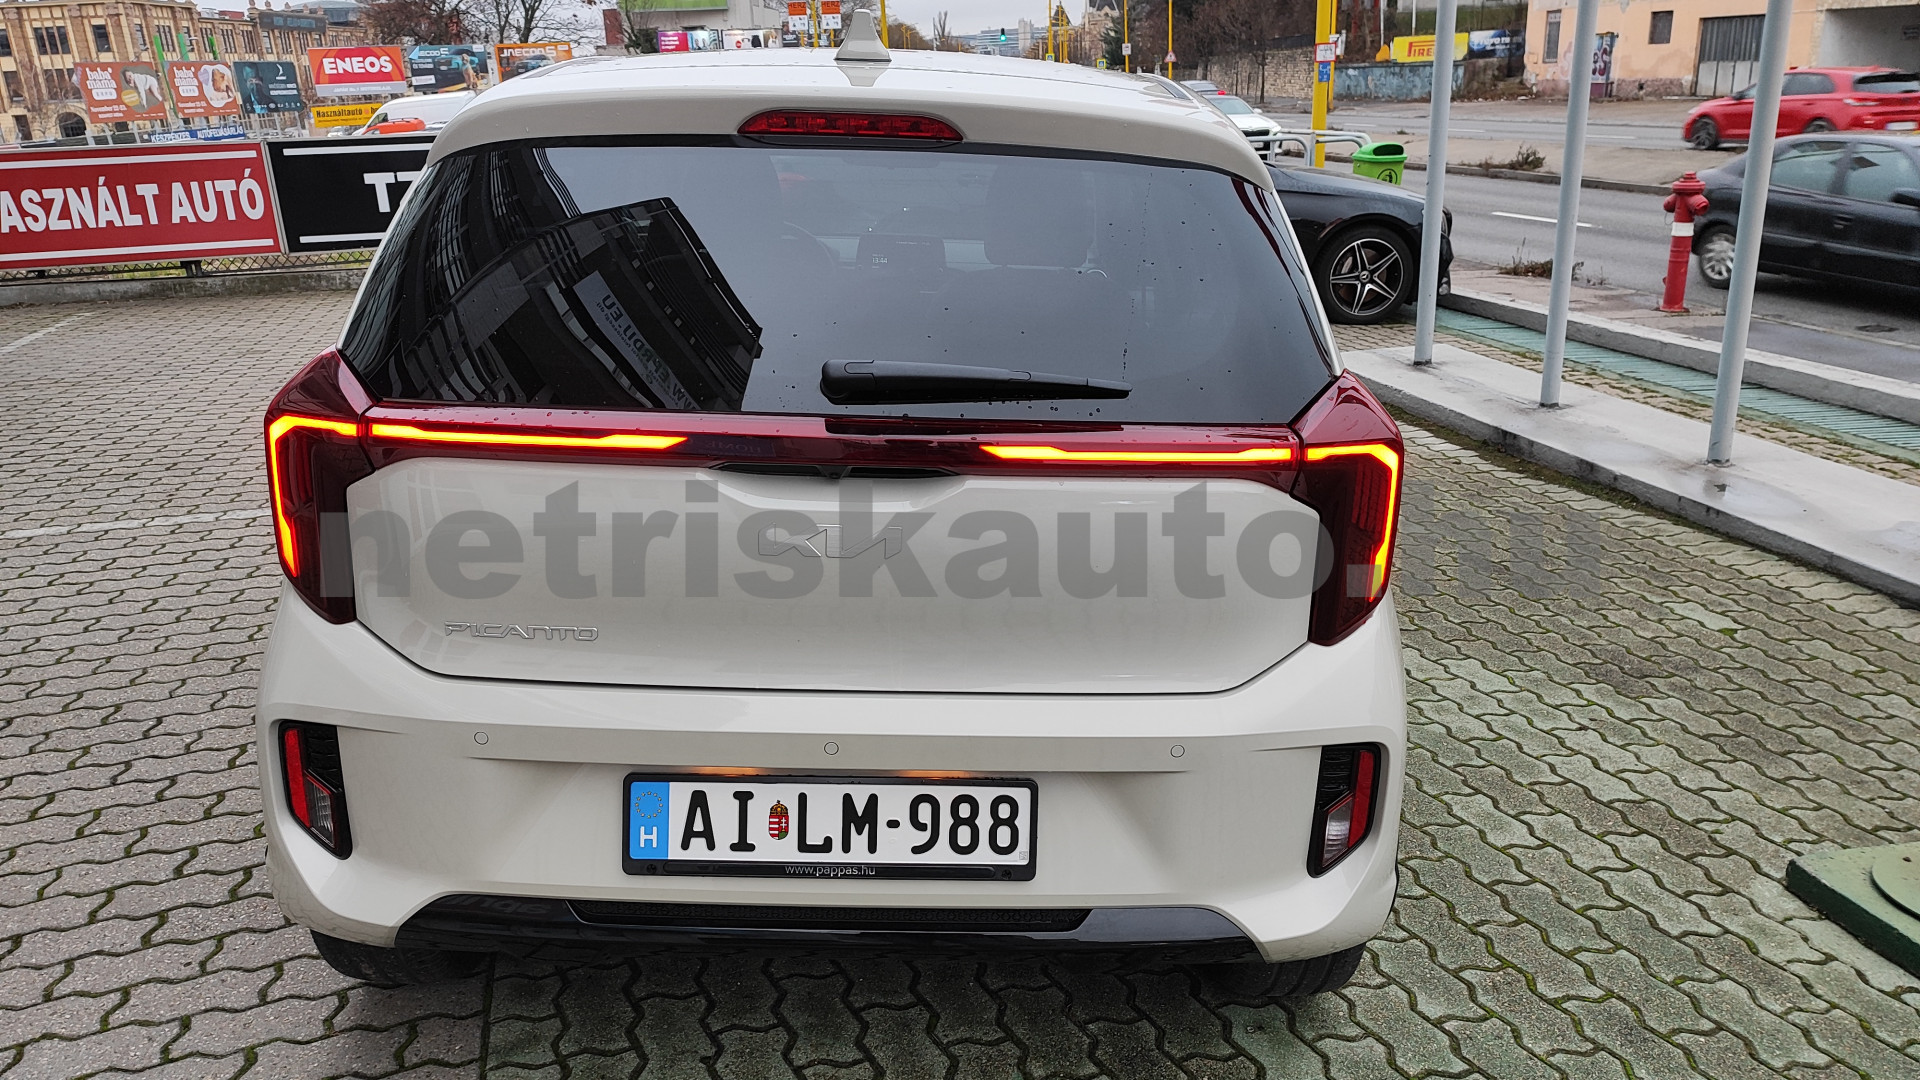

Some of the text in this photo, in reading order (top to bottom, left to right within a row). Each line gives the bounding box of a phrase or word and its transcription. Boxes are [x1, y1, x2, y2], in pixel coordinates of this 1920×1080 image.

[1407, 40, 1436, 57] PIRE
[322, 56, 393, 74] ENEOS
[86, 79, 117, 89] mama
[316, 108, 363, 118] Használtautó
[171, 168, 265, 224] AUTÓ
[757, 523, 903, 558] KIA
[444, 621, 599, 642] PICANTO
[639, 790, 1020, 856] H AI LM-988
[784, 863, 876, 876] www.pappas.hu
